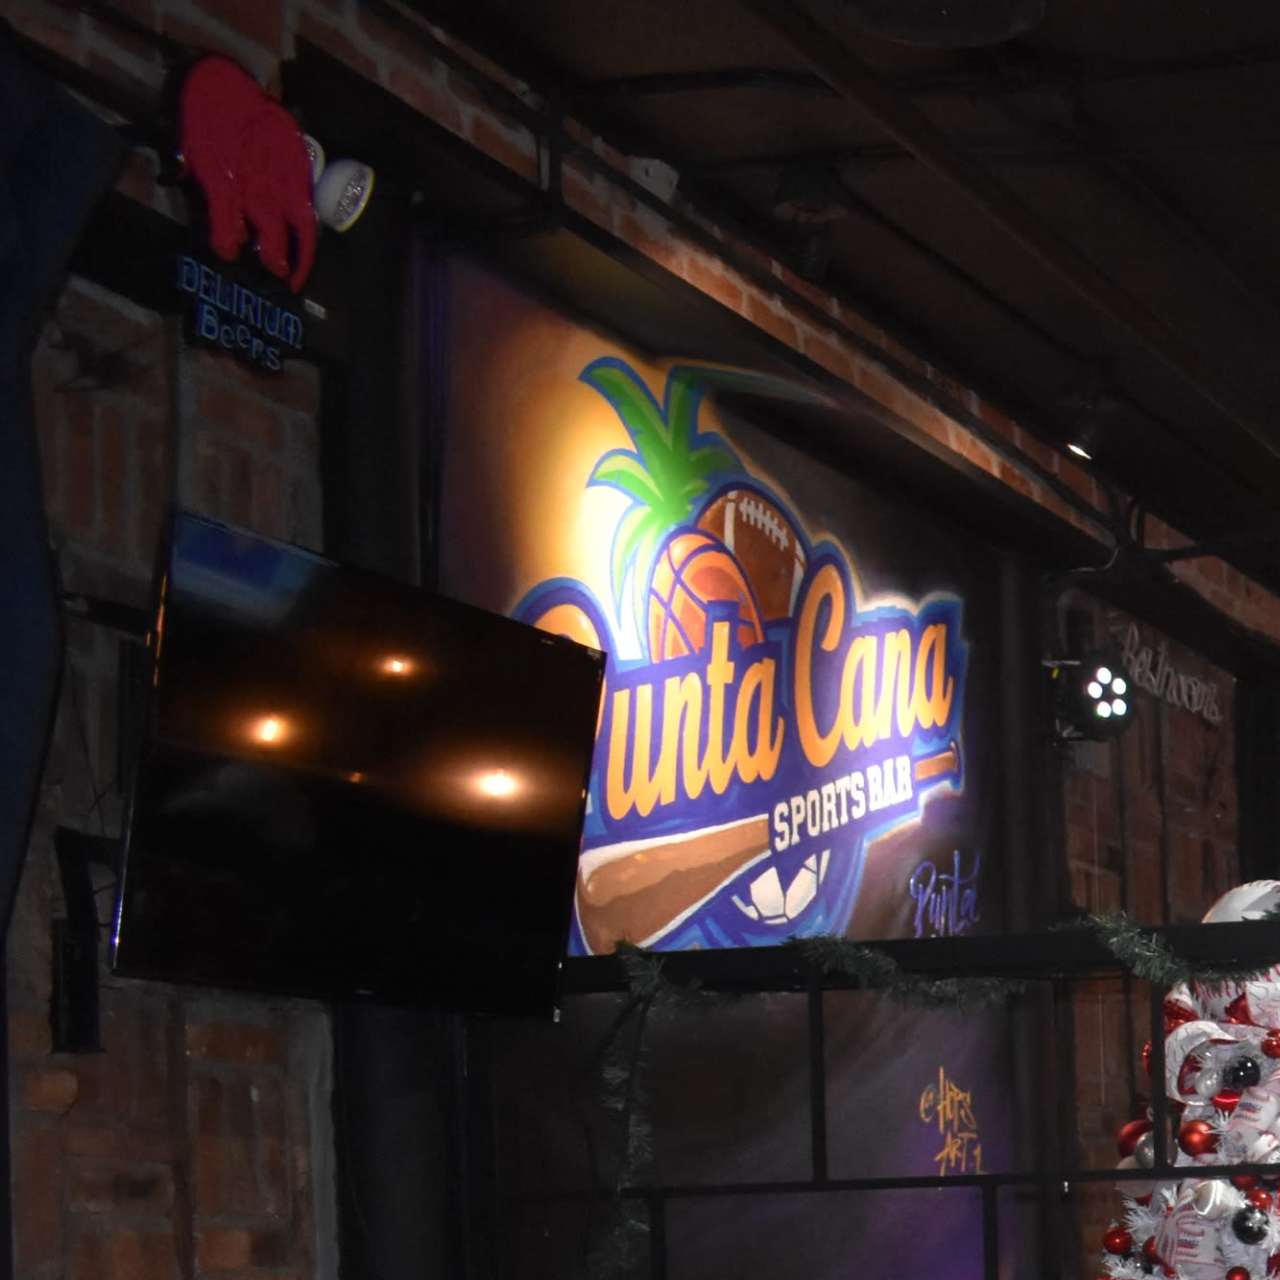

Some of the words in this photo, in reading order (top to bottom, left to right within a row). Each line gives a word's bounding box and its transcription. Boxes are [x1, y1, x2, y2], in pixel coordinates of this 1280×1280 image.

[795, 564, 954, 768] Cana
[774, 776, 866, 852] SPORTS
[866, 754, 913, 813] BAR
